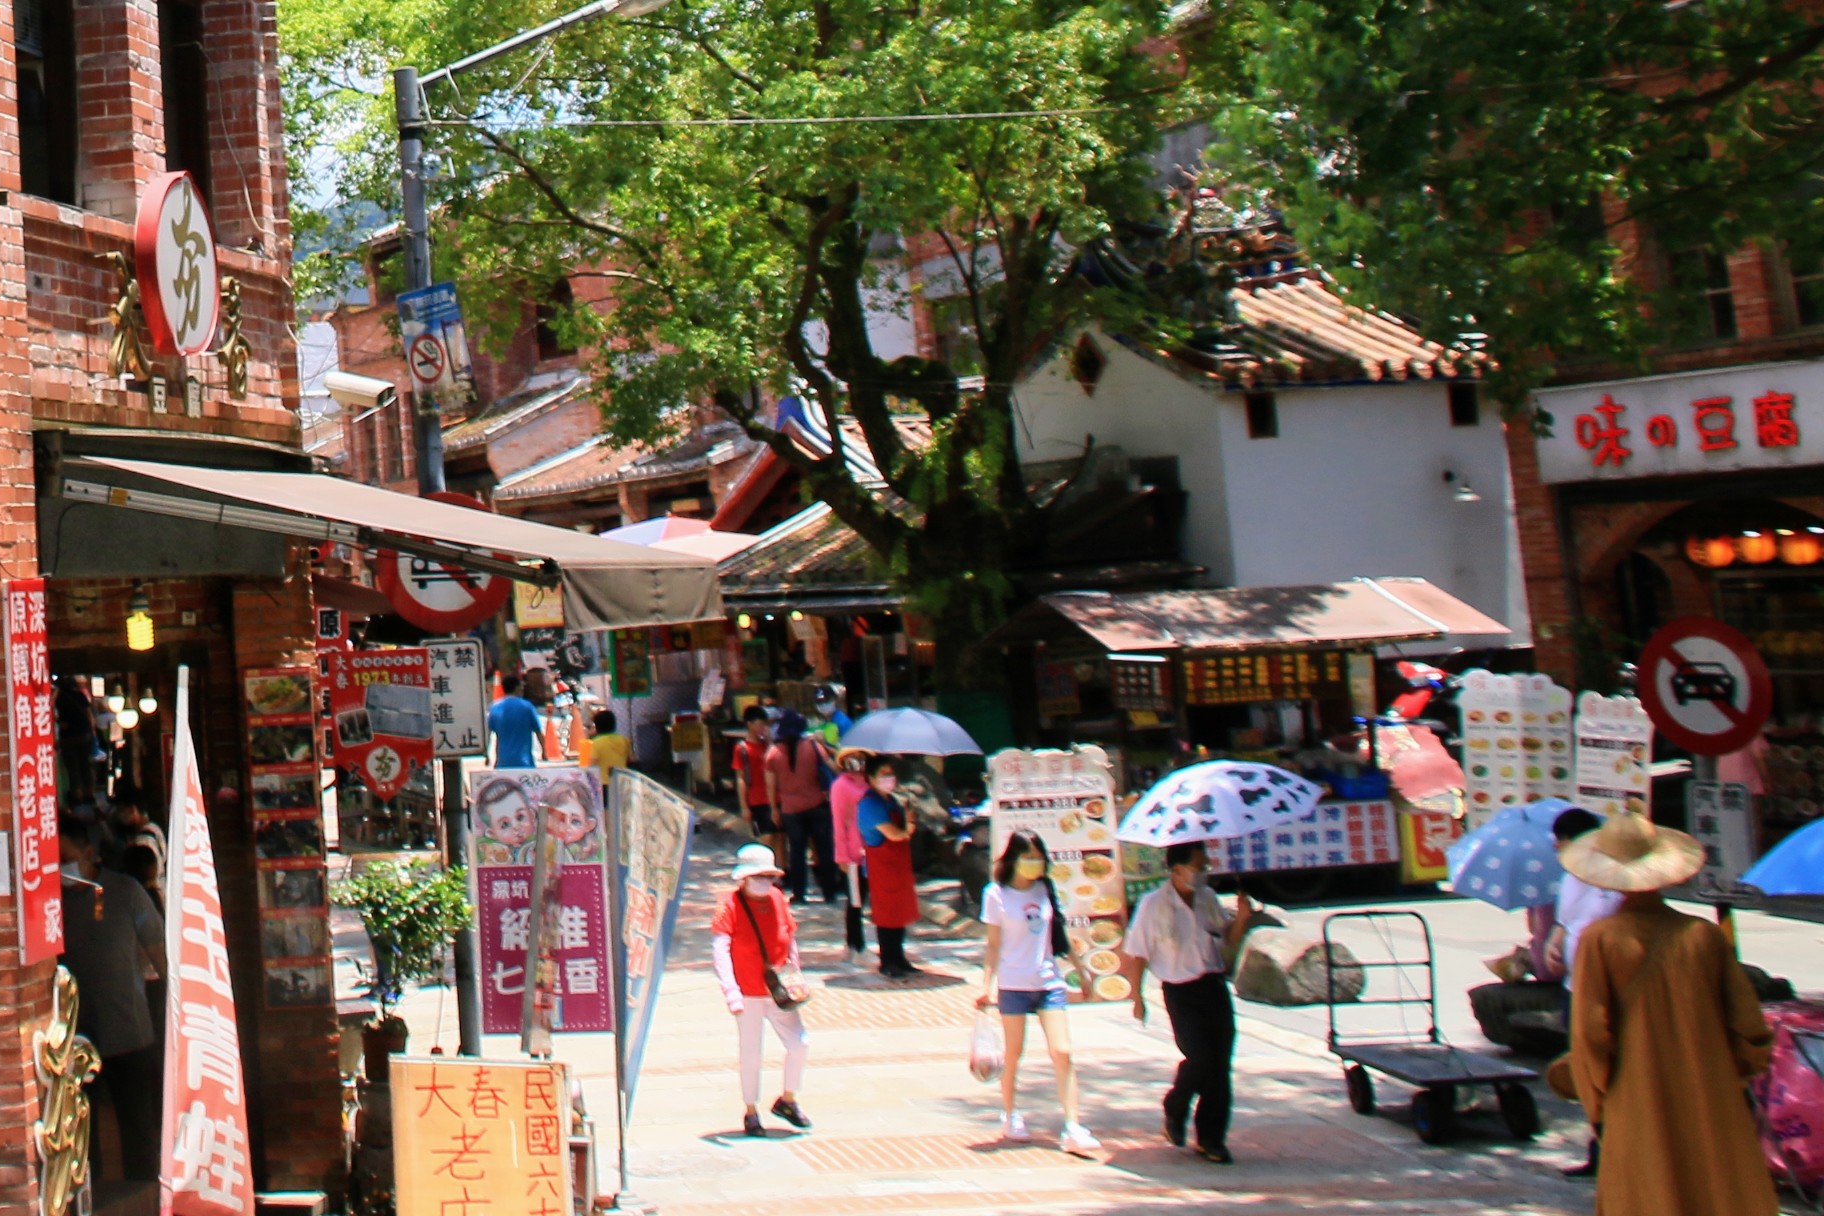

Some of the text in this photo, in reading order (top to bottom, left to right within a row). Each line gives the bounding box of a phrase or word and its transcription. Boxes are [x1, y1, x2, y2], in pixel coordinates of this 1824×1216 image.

[1576, 390, 1800, 468] 味の豆腐
[430, 648, 455, 751] 汽車進入
[454, 647, 481, 749] 禁止
[28, 590, 64, 945] 深坑老街第一家
[491, 957, 599, 996] 七香
[415, 1065, 509, 1119] 大春
